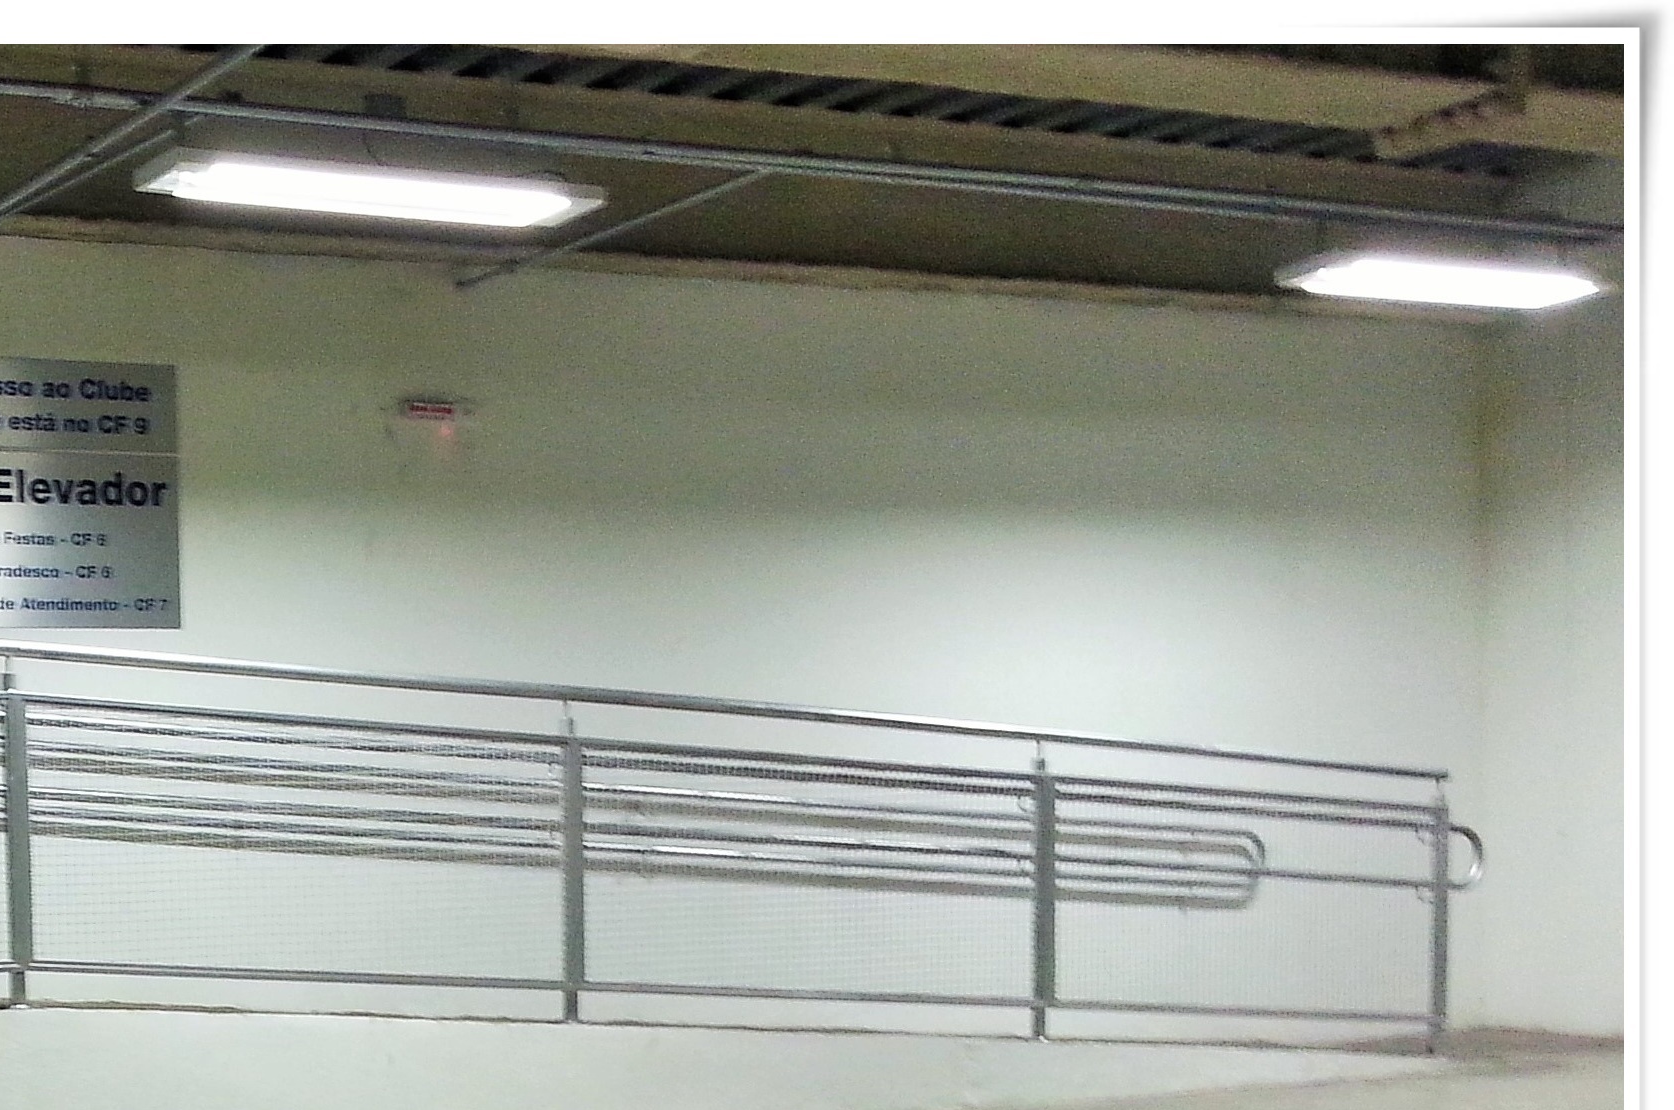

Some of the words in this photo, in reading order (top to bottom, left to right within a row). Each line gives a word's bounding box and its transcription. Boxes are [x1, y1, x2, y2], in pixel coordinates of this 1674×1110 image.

[42, 381, 70, 399] ao
[78, 378, 152, 402] Clube
[8, 413, 56, 432] está
[62, 416, 89, 433] no
[97, 414, 127, 434] CF
[133, 416, 150, 435] 9
[3, 531, 55, 546] Festas
[70, 532, 92, 546] CF
[75, 565, 97, 579] CF
[20, 597, 118, 612] Atendimento
[134, 598, 155, 612] CF
